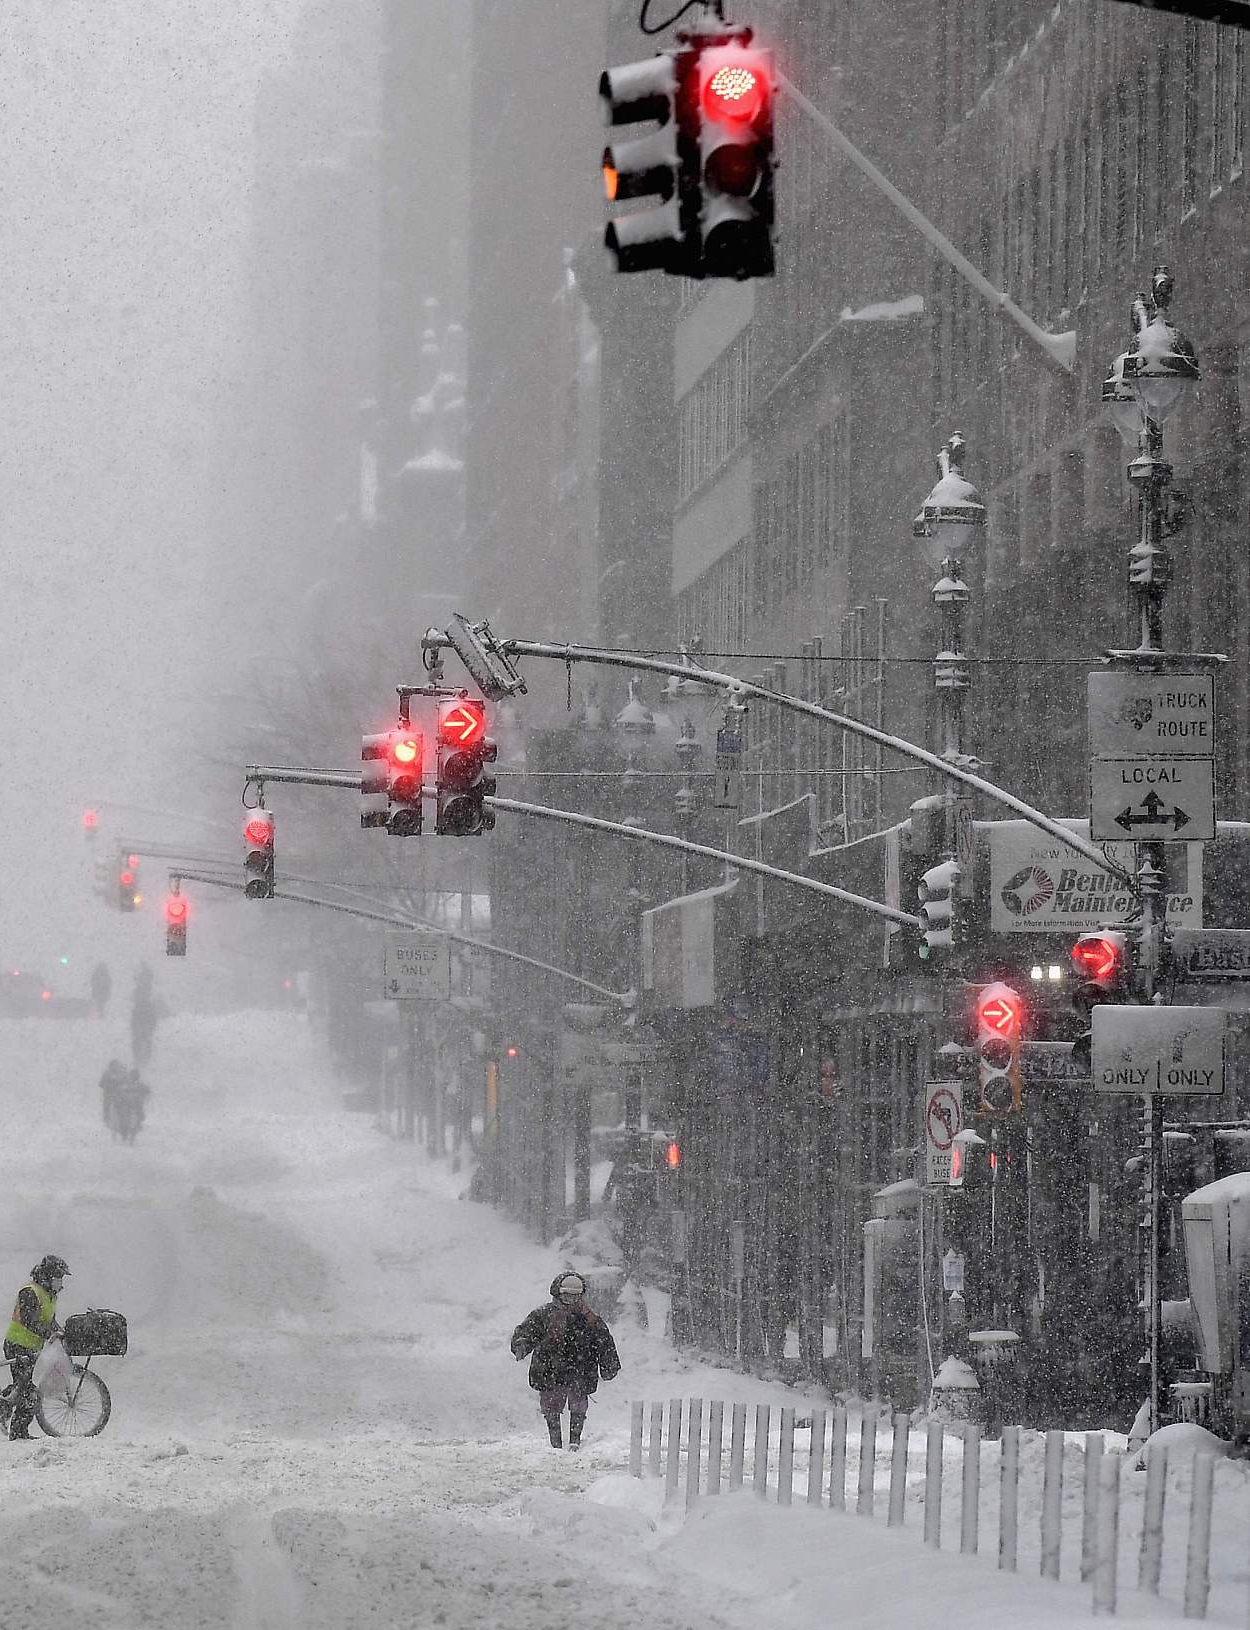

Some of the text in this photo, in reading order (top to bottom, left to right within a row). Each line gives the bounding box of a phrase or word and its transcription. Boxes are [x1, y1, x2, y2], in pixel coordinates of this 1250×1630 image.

[1158, 693, 1207, 708] TRUCK
[1158, 721, 1207, 737] ROUTE
[1122, 768, 1182, 783] LOCAL
[397, 949, 438, 961] BUSES
[400, 964, 433, 976] ONLY
[1103, 1068, 1214, 1086] ONLY ONLY
[933, 1168, 951, 1179] BUSE
